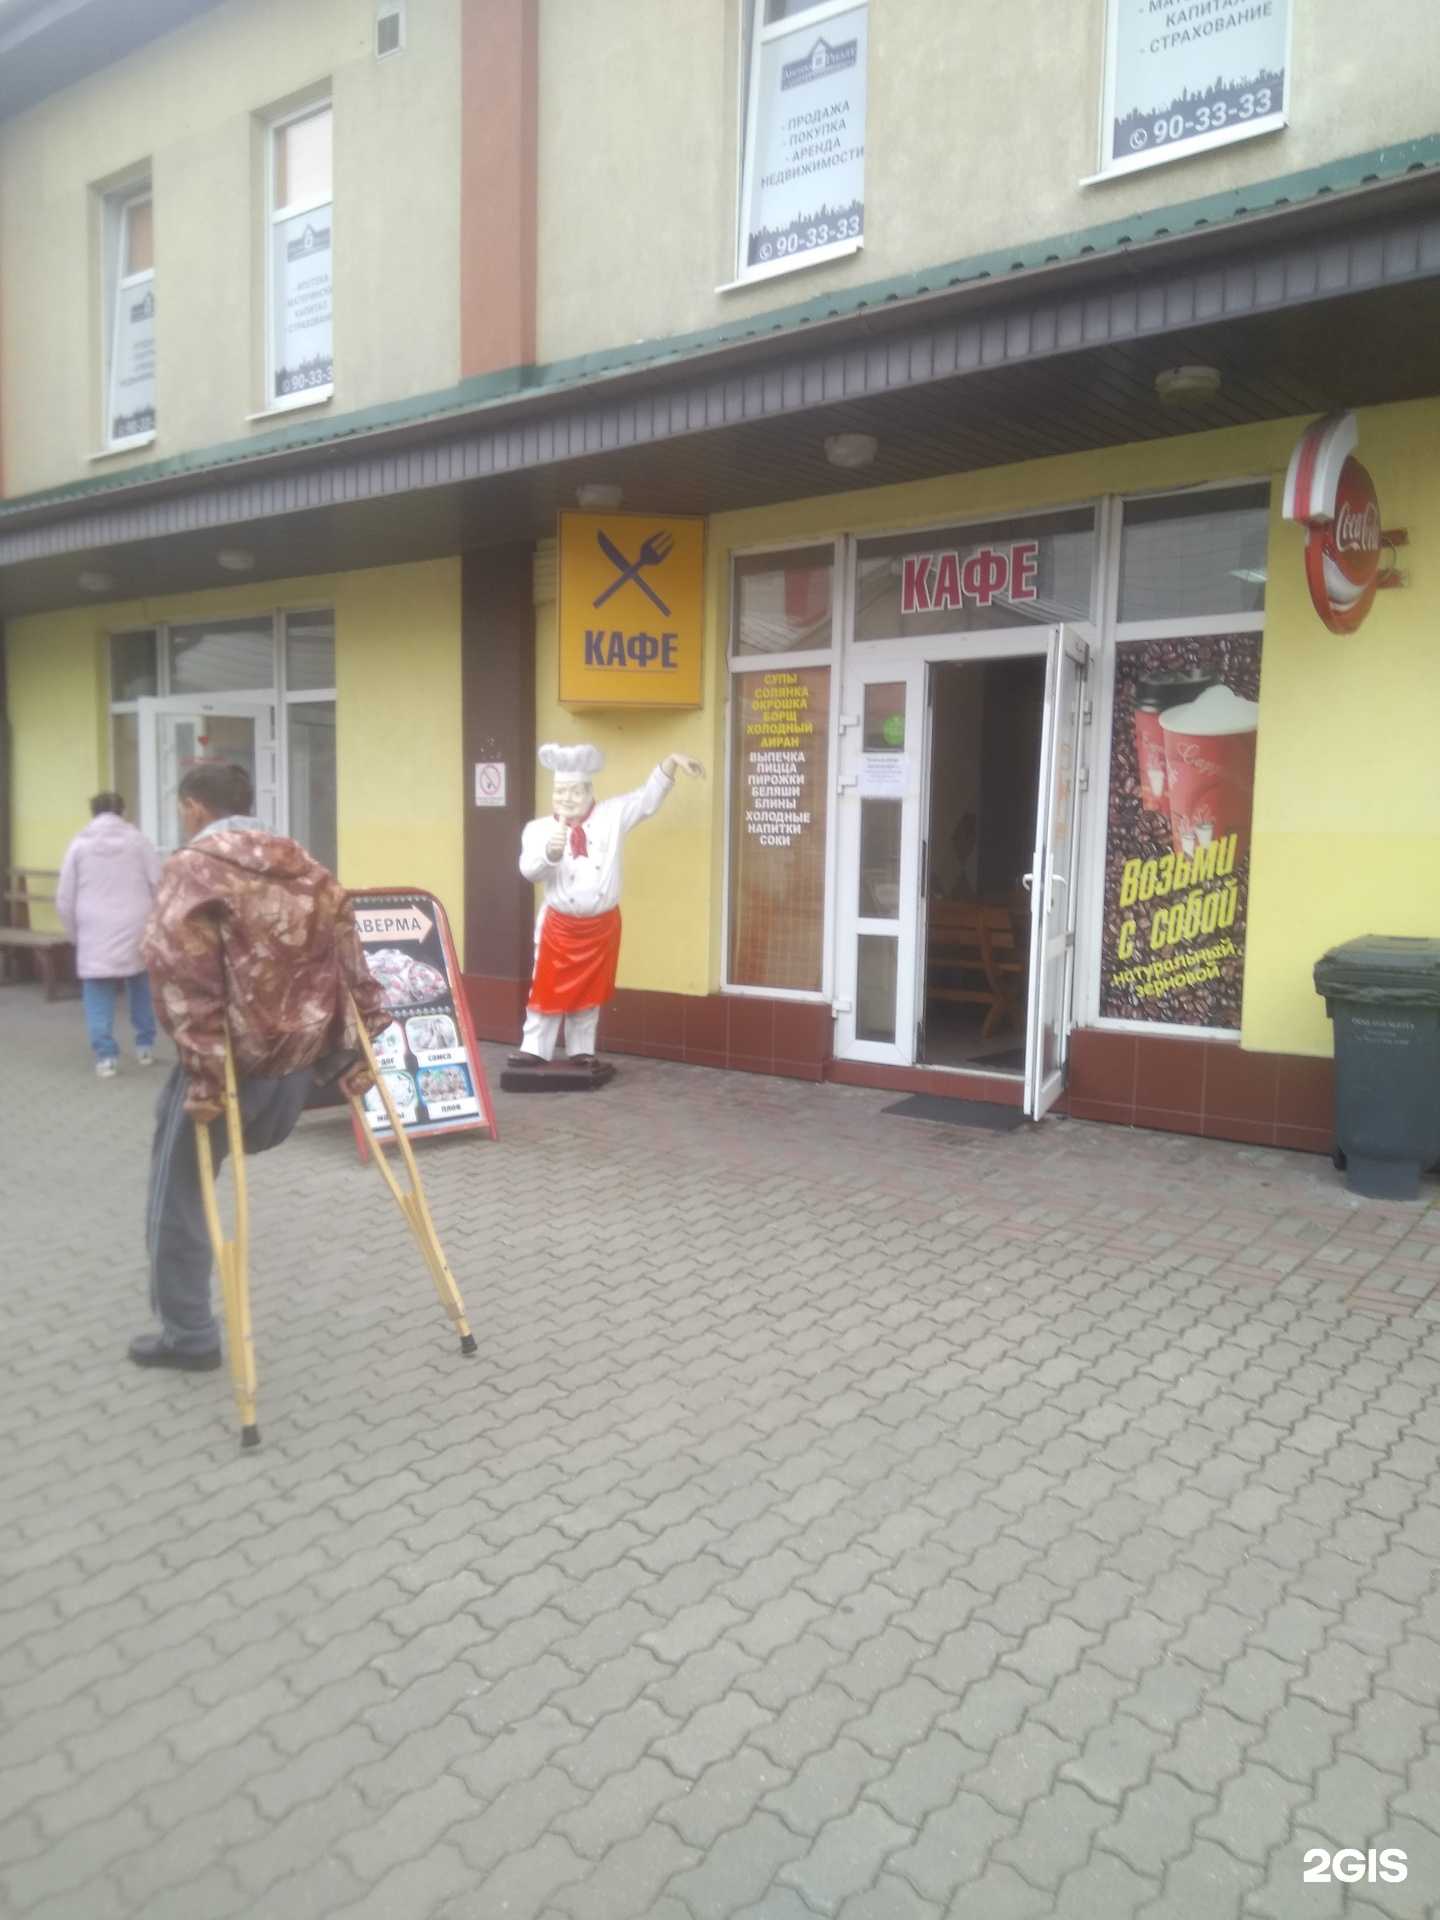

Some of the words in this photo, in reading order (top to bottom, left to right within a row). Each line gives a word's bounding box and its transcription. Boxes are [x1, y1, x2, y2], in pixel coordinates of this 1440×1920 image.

[1149, 2, 1273, 53] СТРАХОВАНИЕ
[787, 100, 851, 132] ПРОДАЖА
[1153, 88, 1272, 143] 90-33-33
[788, 118, 847, 147] ПОКУПКА
[791, 137, 841, 162] АРЕНДА
[760, 146, 864, 189] НЕДВИЖИМОСТИ
[776, 215, 860, 256] 90-33-33
[902, 541, 1039, 614] КАФЕ
[584, 629, 679, 669] КАФЕ
[752, 699, 808, 711] ОКРОШКА
[763, 711, 797, 722] БОРЩ
[749, 751, 806, 763] ВЫПЕЧКА
[756, 763, 797, 774] ПИЦЦА
[747, 774, 805, 786] ПИРОЖКИ
[752, 786, 801, 797] БЕЛЯШИ
[755, 798, 797, 809] БЛИНЫ
[745, 809, 811, 824] ХОЛОДНЫЕ
[747, 823, 801, 834] НАПИТКИ
[759, 835, 791, 846] СОКИ
[1119, 833, 1238, 908] ВОЗЬМИ
[354, 917, 422, 933] АВЕРМА
